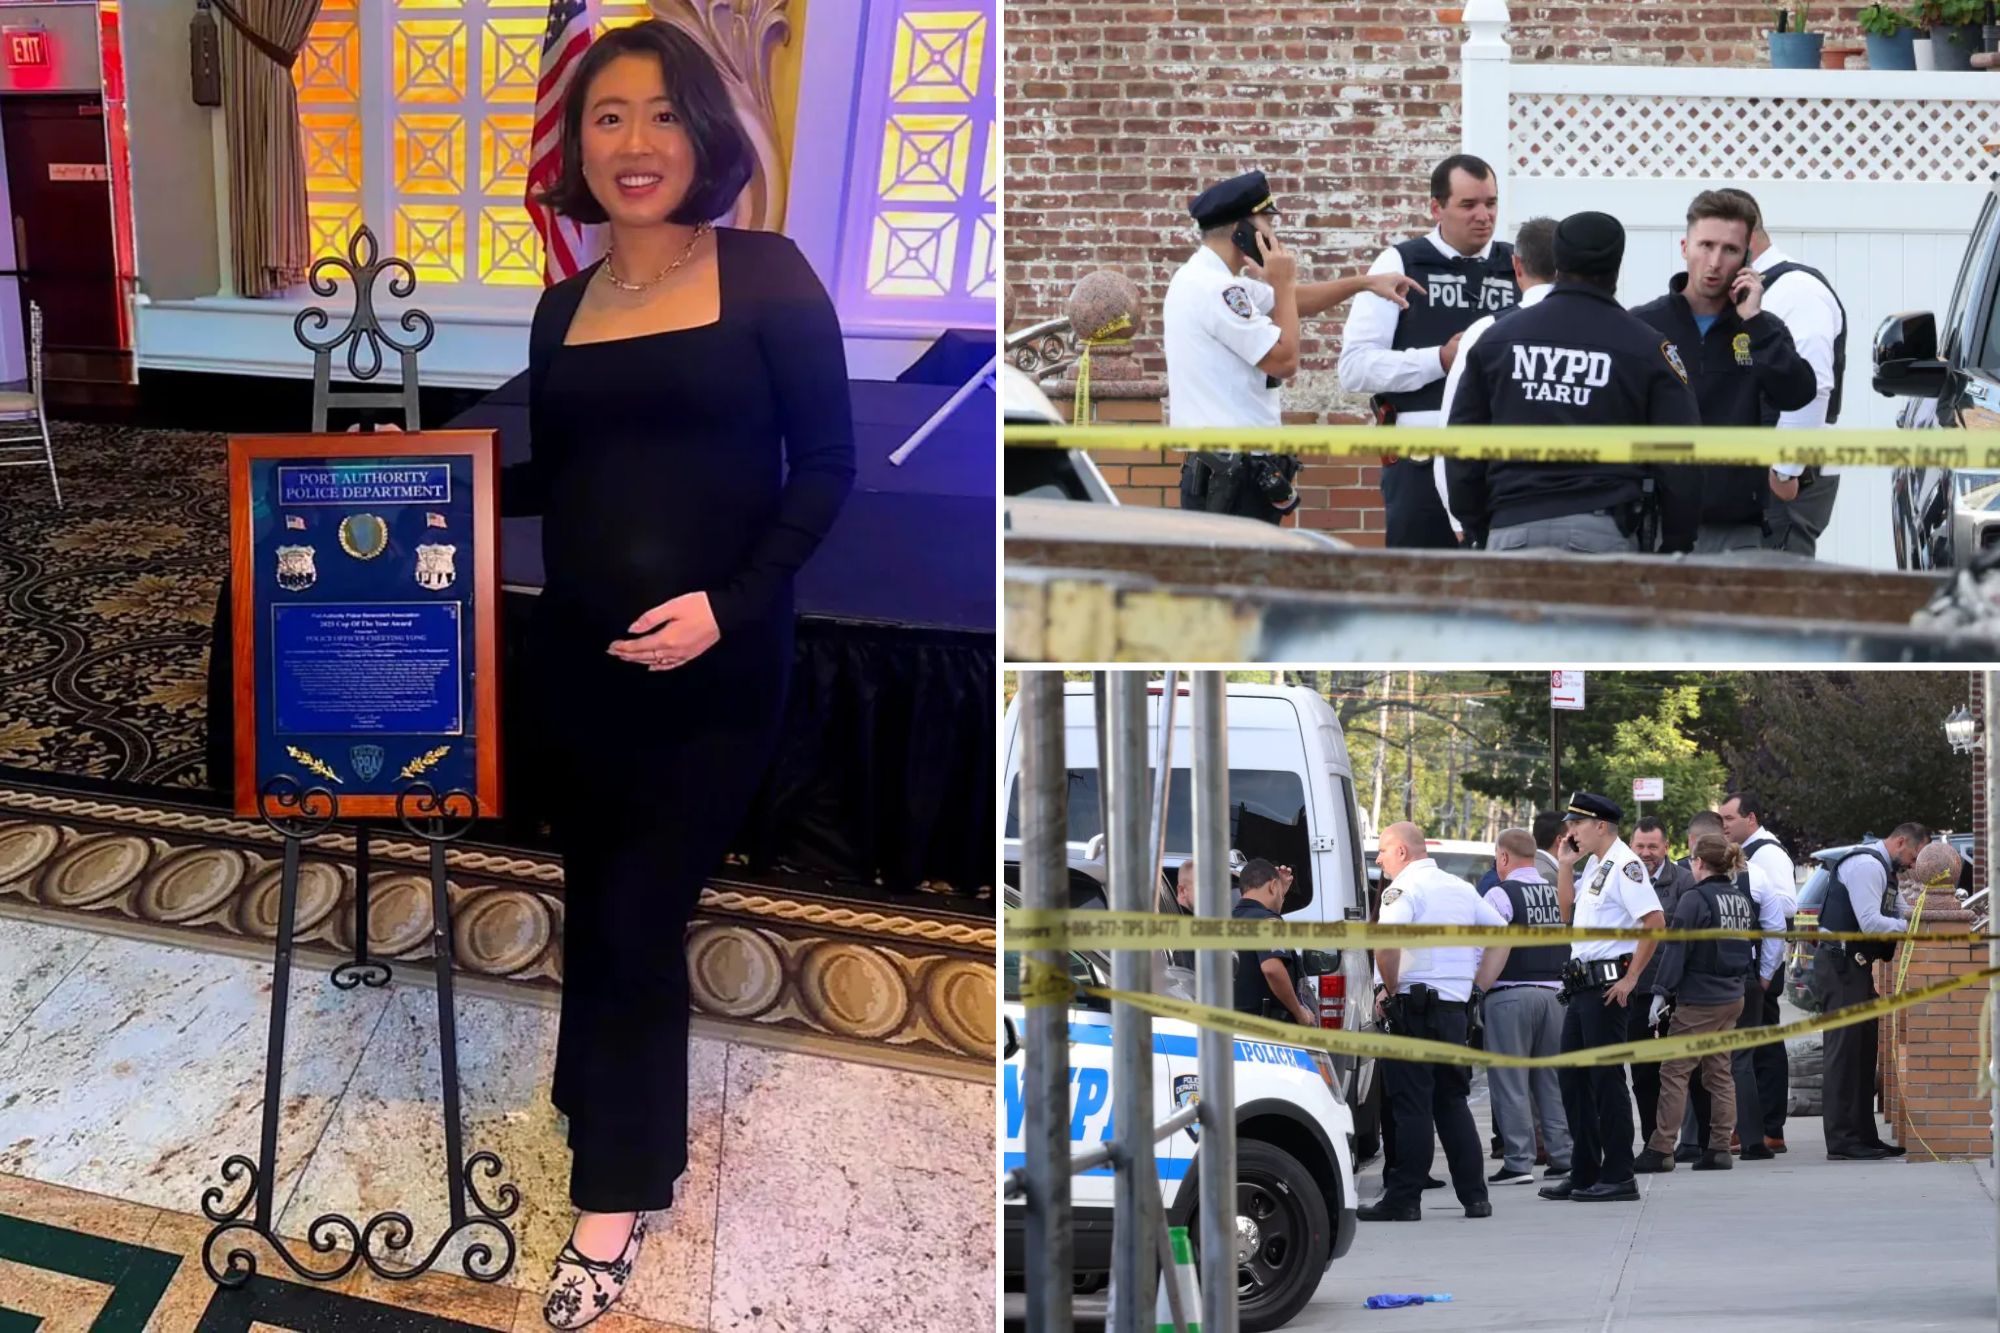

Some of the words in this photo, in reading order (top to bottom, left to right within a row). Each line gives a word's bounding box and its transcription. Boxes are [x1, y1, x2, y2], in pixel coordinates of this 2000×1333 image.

[13, 37, 40, 63] EXIT
[1428, 283, 1514, 310] POLICE
[1512, 345, 1611, 387] NYPD
[1522, 382, 1591, 405] TARU
[300, 473, 338, 485] PORT
[342, 471, 429, 484] AUTHORITY
[286, 487, 339, 499] POLICE
[342, 484, 443, 498] DEPARTMENT
[1527, 906, 1561, 924] POLIC
[1716, 894, 1750, 917] NYPD
[1190, 920, 1223, 936] CRIME
[1227, 921, 1260, 937] SCENE
[1272, 921, 1286, 938] DO
[1290, 922, 1309, 938] NOT
[1313, 922, 1347, 938] CROSS
[1720, 915, 1751, 931] POLICE
[1603, 963, 1618, 981] U
[1241, 1042, 1297, 1068] POLICE
